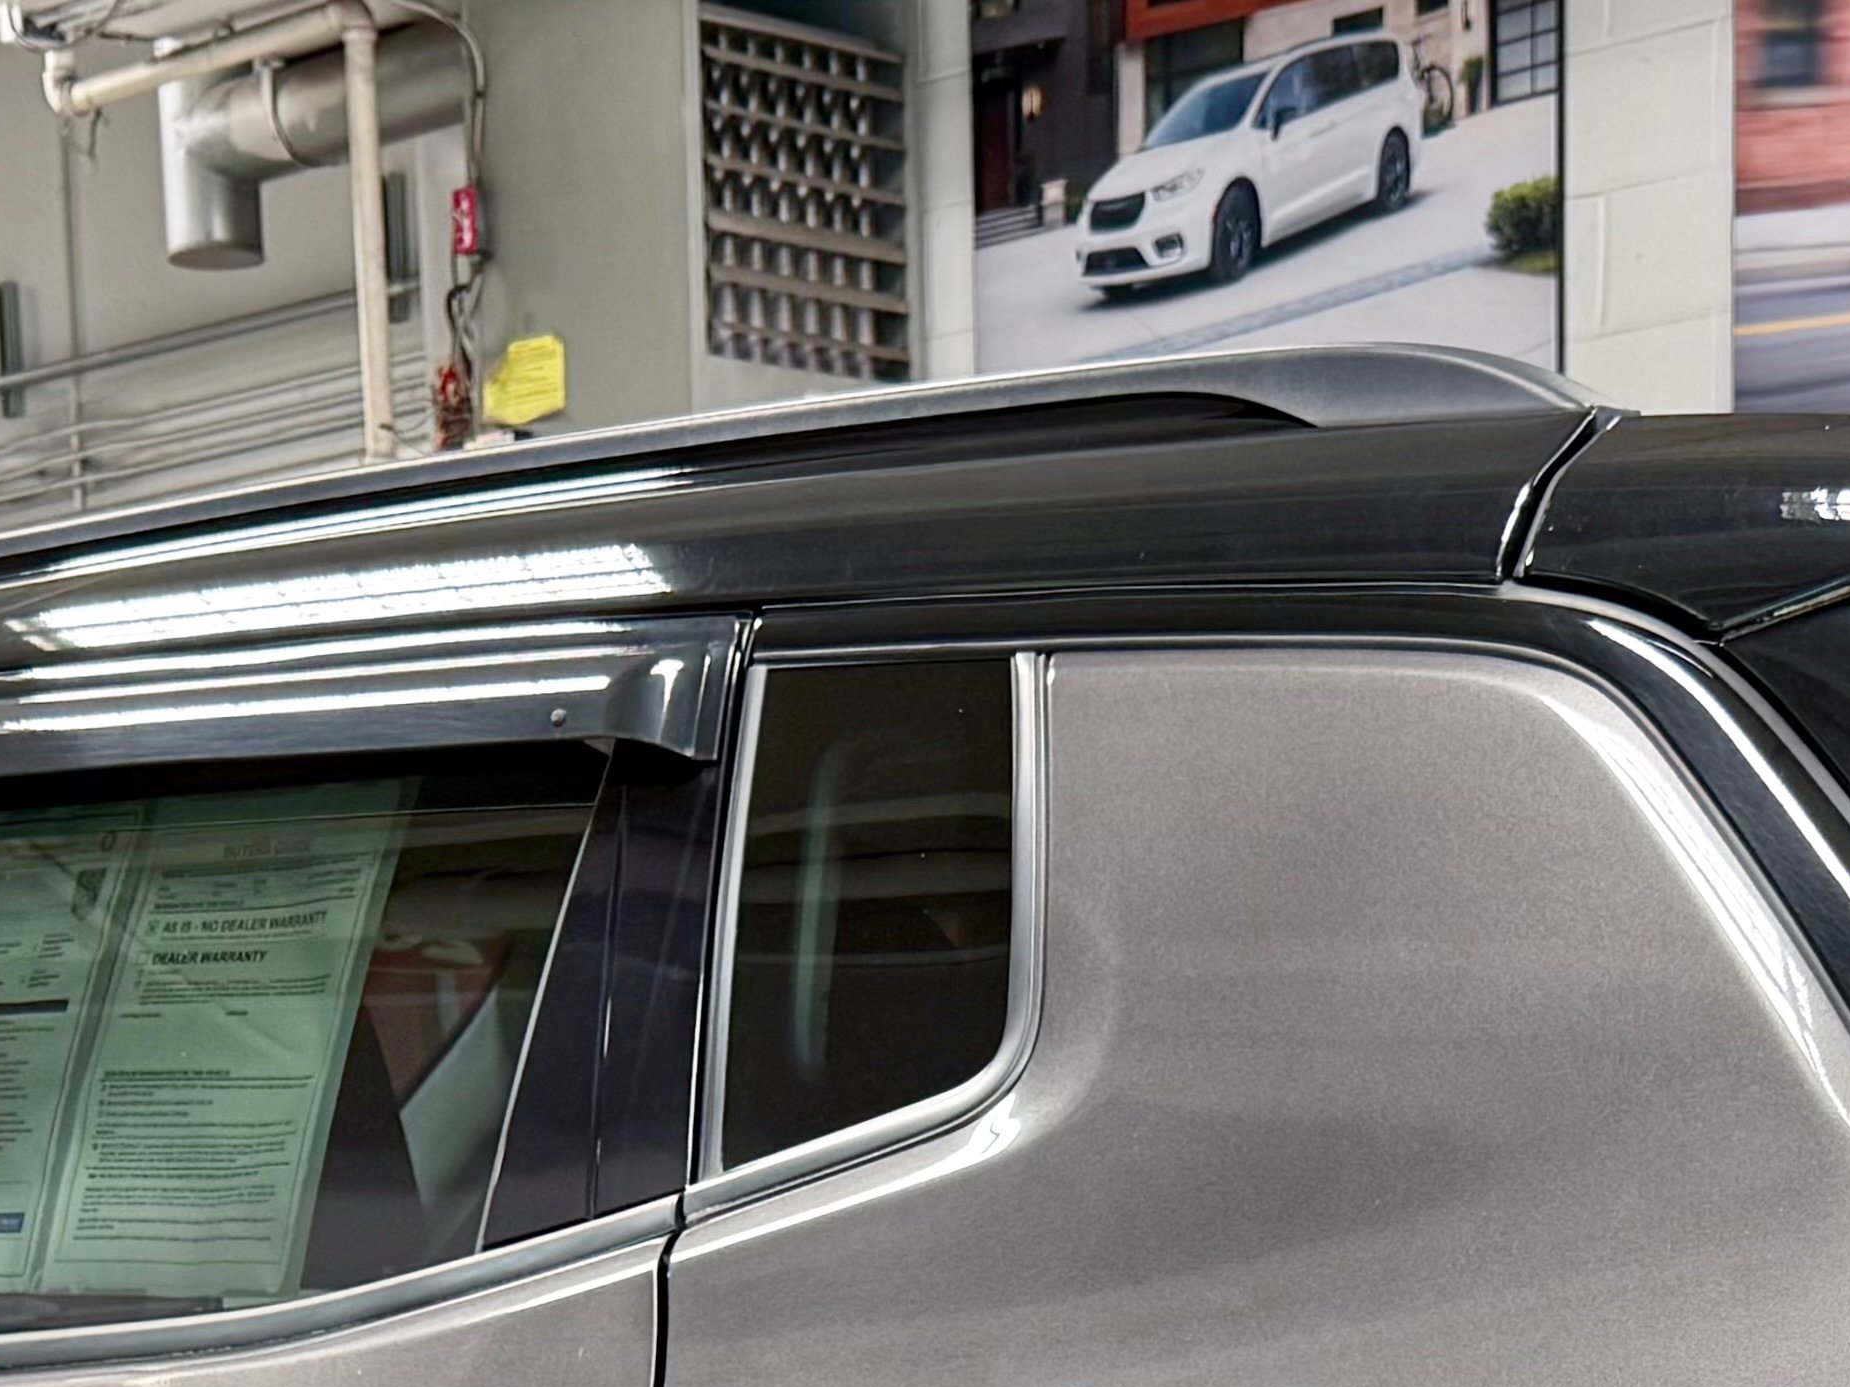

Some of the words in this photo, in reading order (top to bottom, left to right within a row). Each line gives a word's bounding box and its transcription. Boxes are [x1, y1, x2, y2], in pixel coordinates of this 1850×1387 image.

[162, 920, 178, 934] AS
[179, 920, 193, 933] IS
[201, 919, 220, 933] NO
[220, 915, 268, 933] DEALER
[268, 911, 329, 930] WARRANTY
[152, 951, 199, 966] DEALER
[199, 950, 269, 965] WARRANTY
